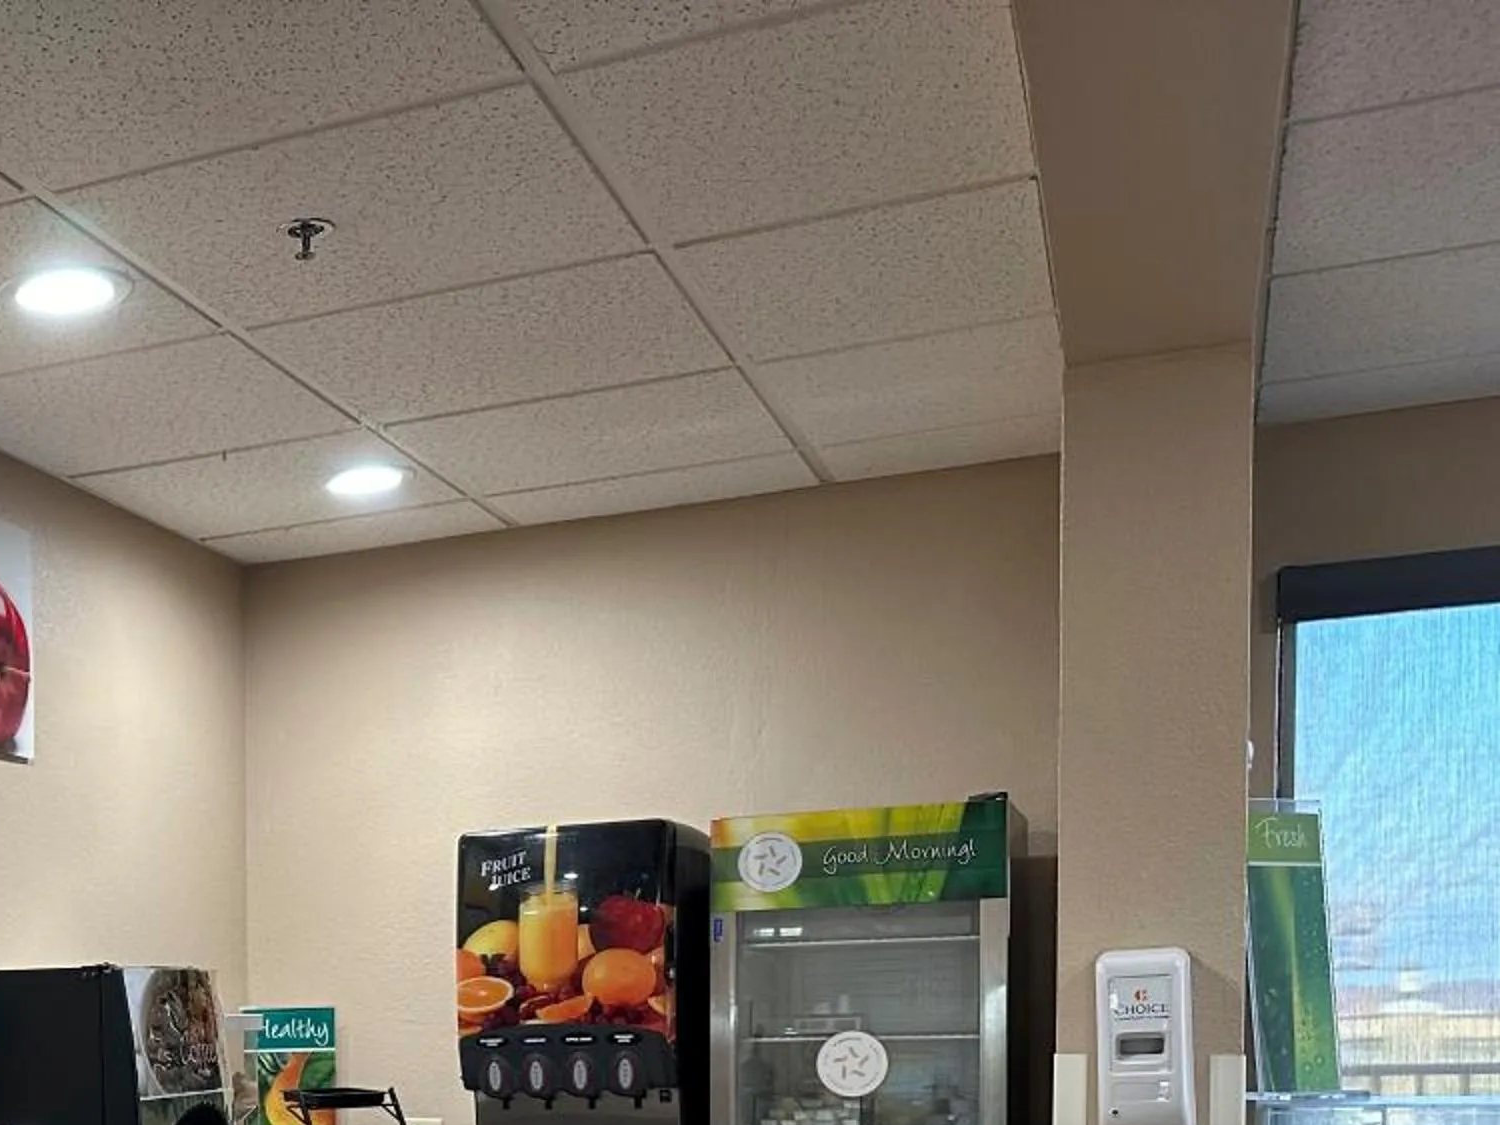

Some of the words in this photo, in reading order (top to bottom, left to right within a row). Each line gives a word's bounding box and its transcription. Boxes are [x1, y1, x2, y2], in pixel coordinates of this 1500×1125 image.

[1254, 816, 1307, 849] Fresh
[481, 850, 527, 877] FRUIT
[823, 843, 869, 875] Good
[875, 838, 977, 865] Morning!
[489, 867, 531, 891] JUICE
